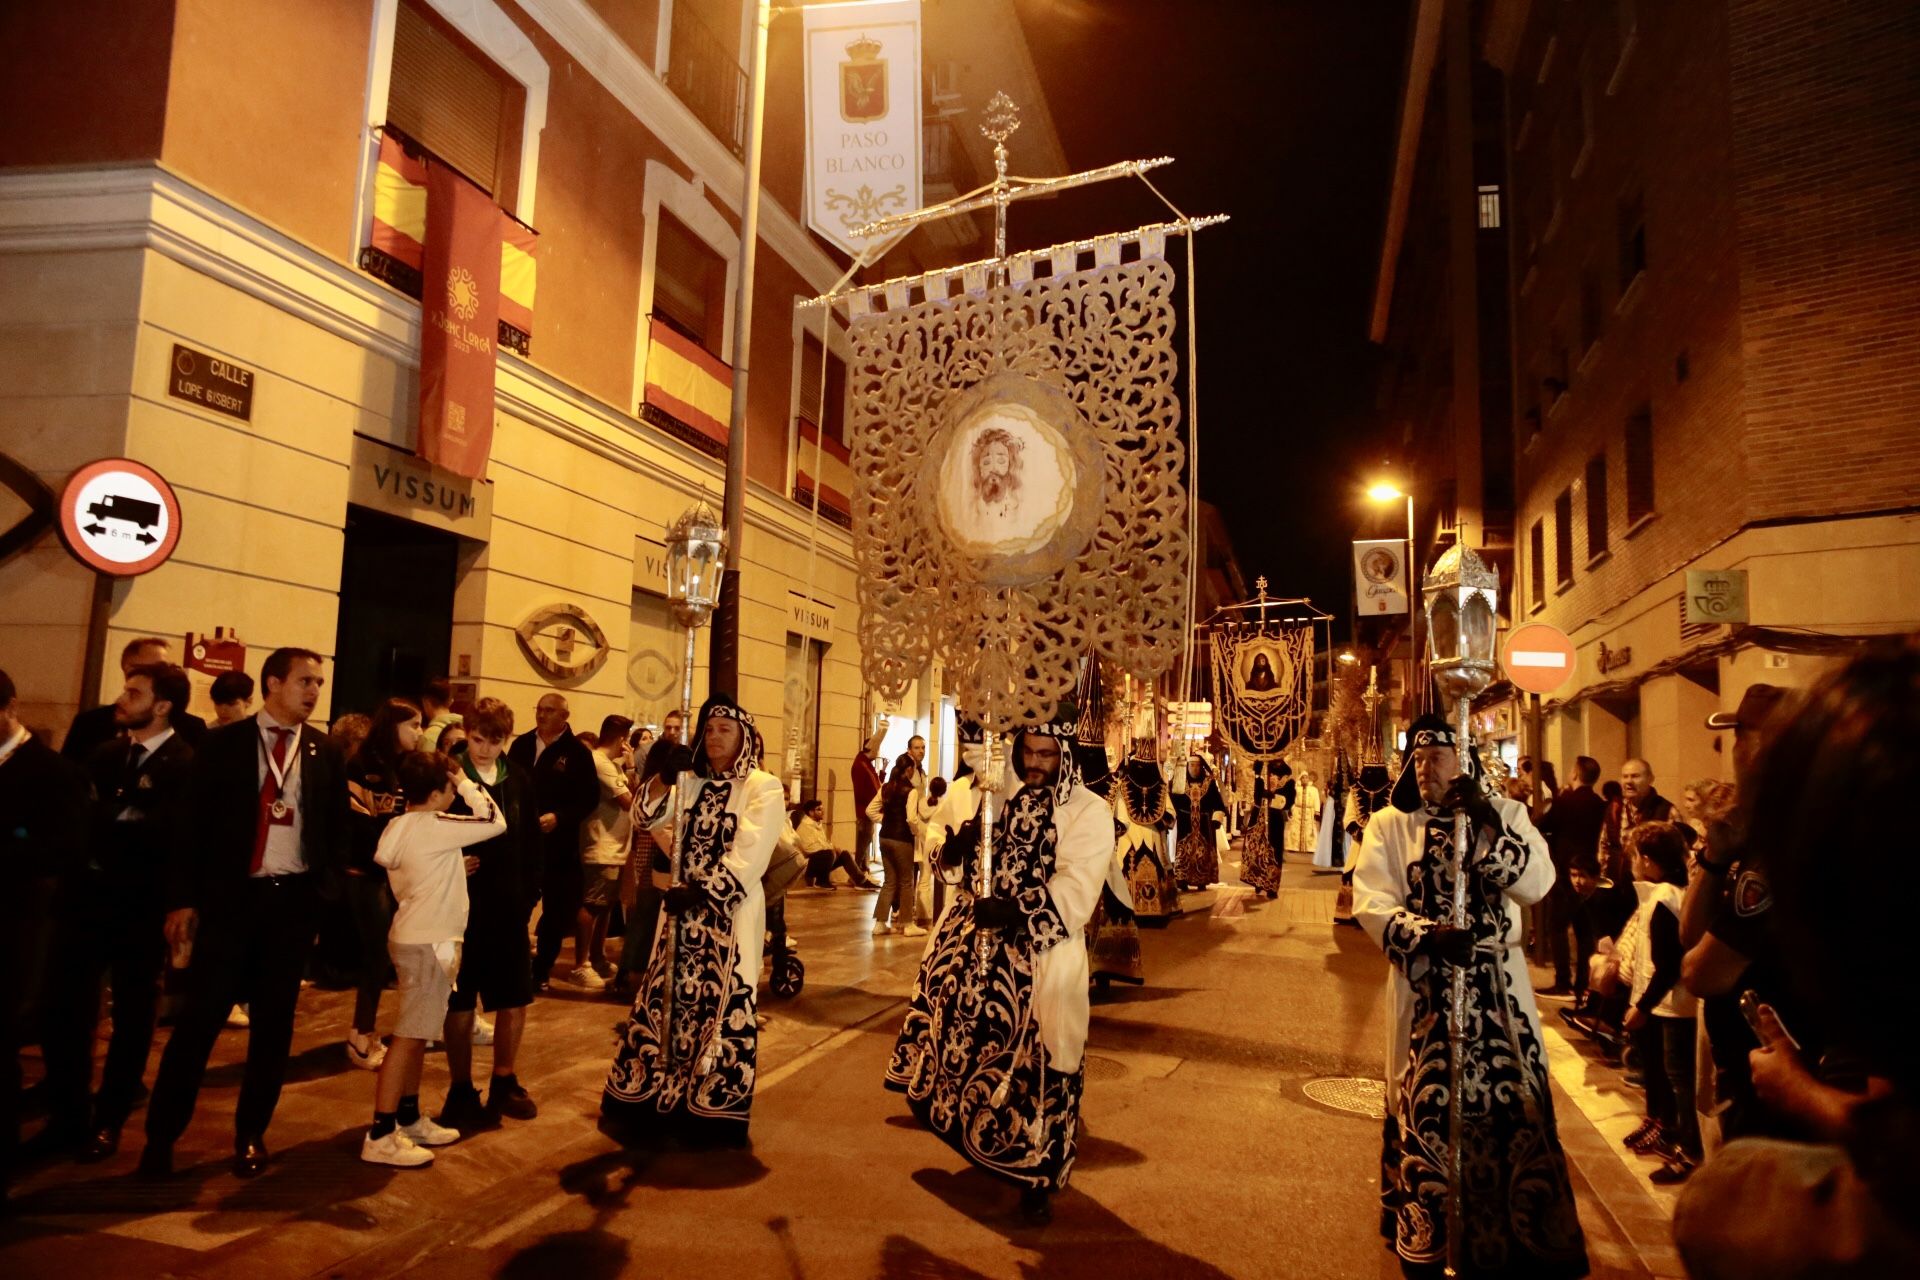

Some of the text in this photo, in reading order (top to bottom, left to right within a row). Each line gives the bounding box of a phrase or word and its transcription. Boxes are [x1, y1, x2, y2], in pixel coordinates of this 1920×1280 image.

[841, 131, 888, 149] PASO
[826, 153, 905, 173] BLANCO
[210, 359, 249, 388] CALLE
[178, 379, 243, 413] LOPE GISBERT
[373, 463, 475, 518] VISSUM
[111, 528, 131, 540] 6 m
